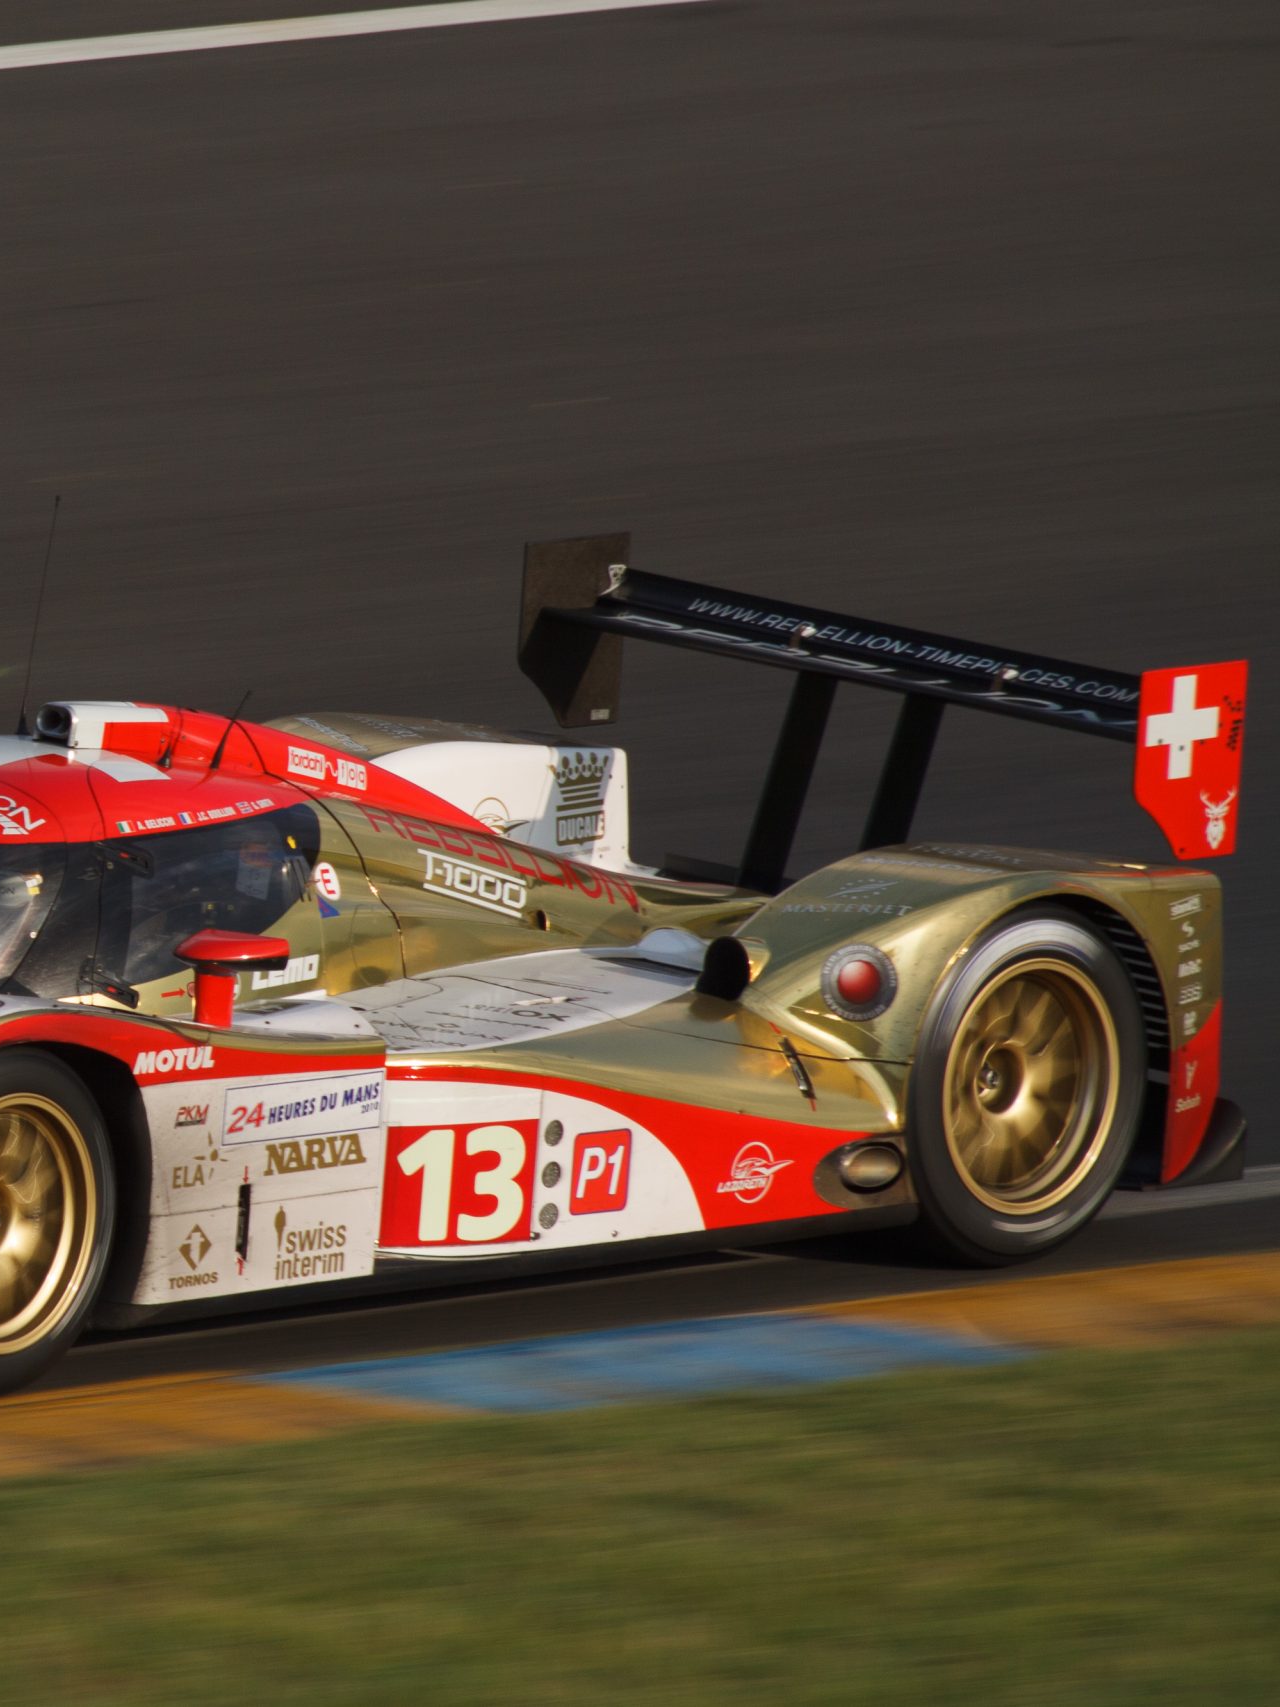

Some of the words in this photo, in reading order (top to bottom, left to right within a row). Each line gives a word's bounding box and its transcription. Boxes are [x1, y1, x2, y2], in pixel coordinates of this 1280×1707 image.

[558, 814, 604, 842] DUCALE
[360, 802, 639, 914] REBELLION
[320, 868, 337, 895] E
[782, 903, 912, 916] MASTERJET
[251, 954, 320, 991] LEMO
[133, 1046, 216, 1075] MOTUL
[175, 1103, 210, 1125] PKM
[226, 1102, 266, 1135] 24
[268, 1097, 316, 1125] HEURES
[320, 1093, 338, 1111] DU
[341, 1082, 381, 1107] MANS
[263, 1133, 367, 1177] NARVA
[171, 1164, 206, 1189] ELA
[397, 1125, 526, 1242] 13
[575, 1144, 626, 1199] P1
[285, 1221, 347, 1254] swiss
[168, 1271, 220, 1290] TORNOS
[275, 1252, 345, 1281] interim
